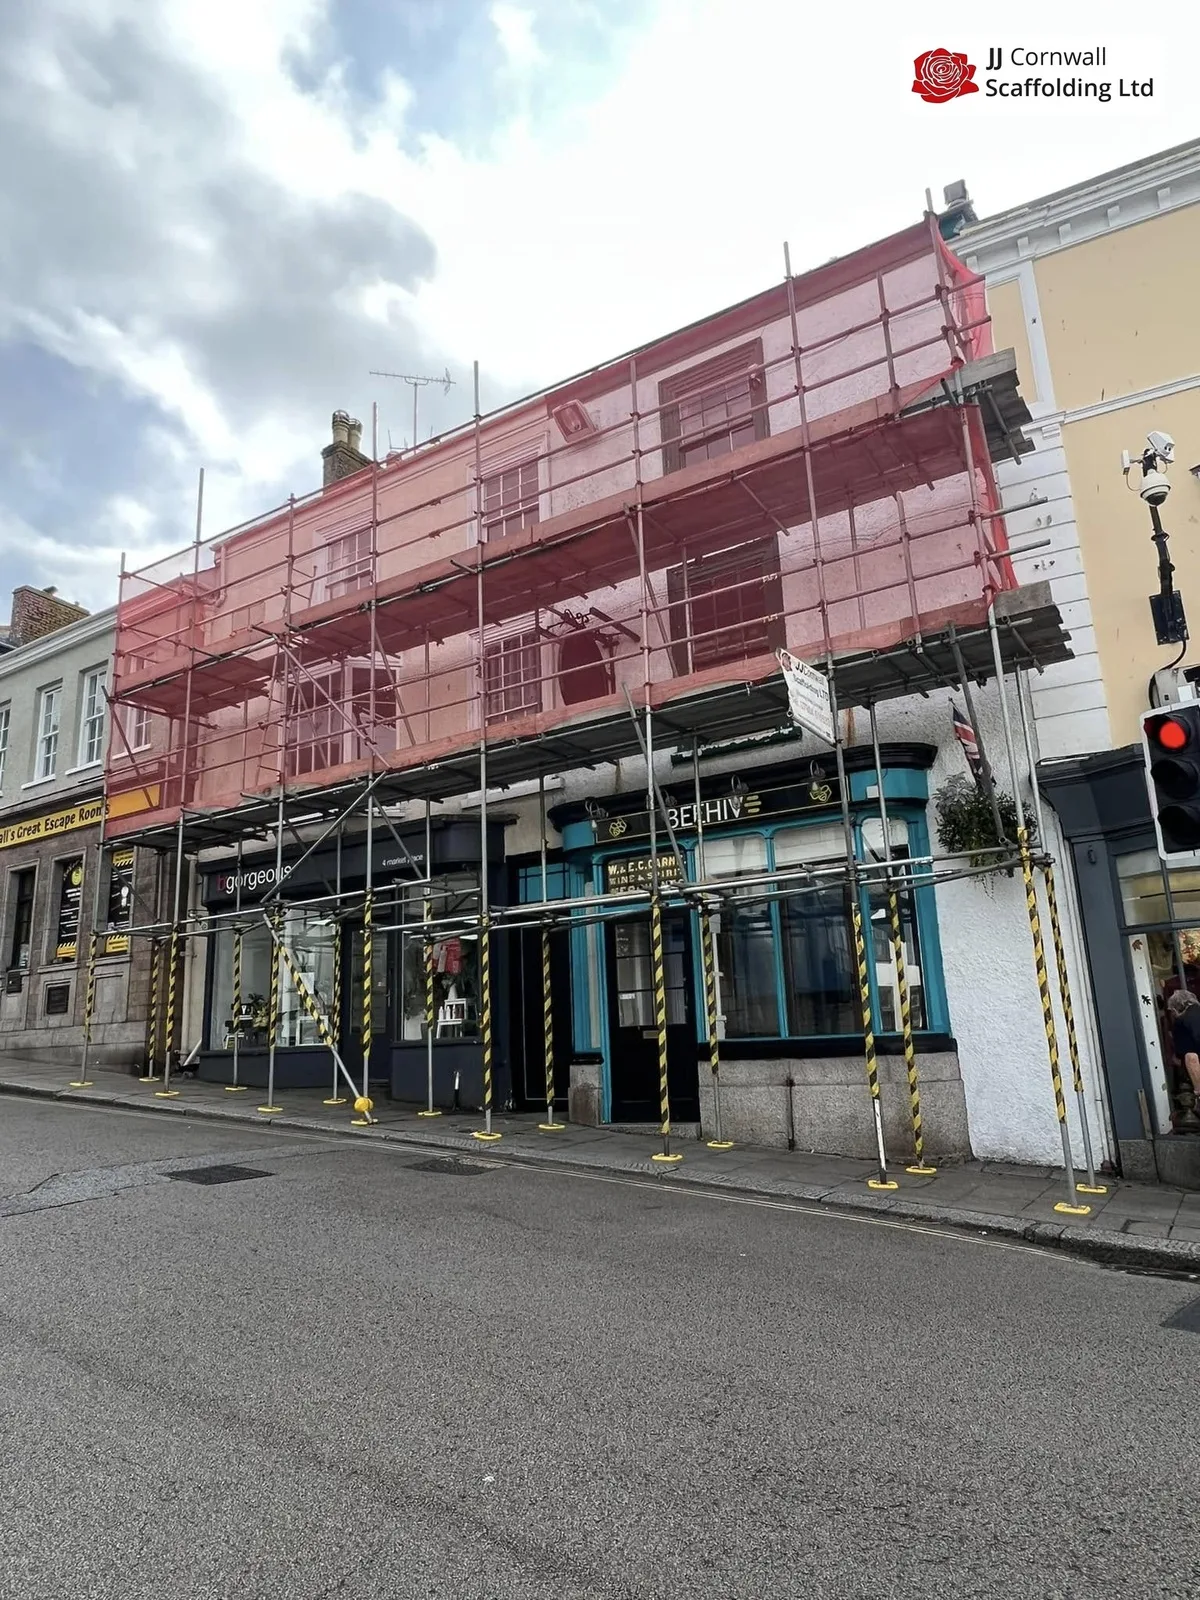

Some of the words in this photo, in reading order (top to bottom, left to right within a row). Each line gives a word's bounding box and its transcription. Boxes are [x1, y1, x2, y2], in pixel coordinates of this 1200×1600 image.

[17, 822, 41, 838] Great
[44, 813, 76, 832] Escape
[667, 795, 762, 829] BEEHIVE
[407, 853, 424, 866] ace
[216, 865, 292, 895] bgorgeous
